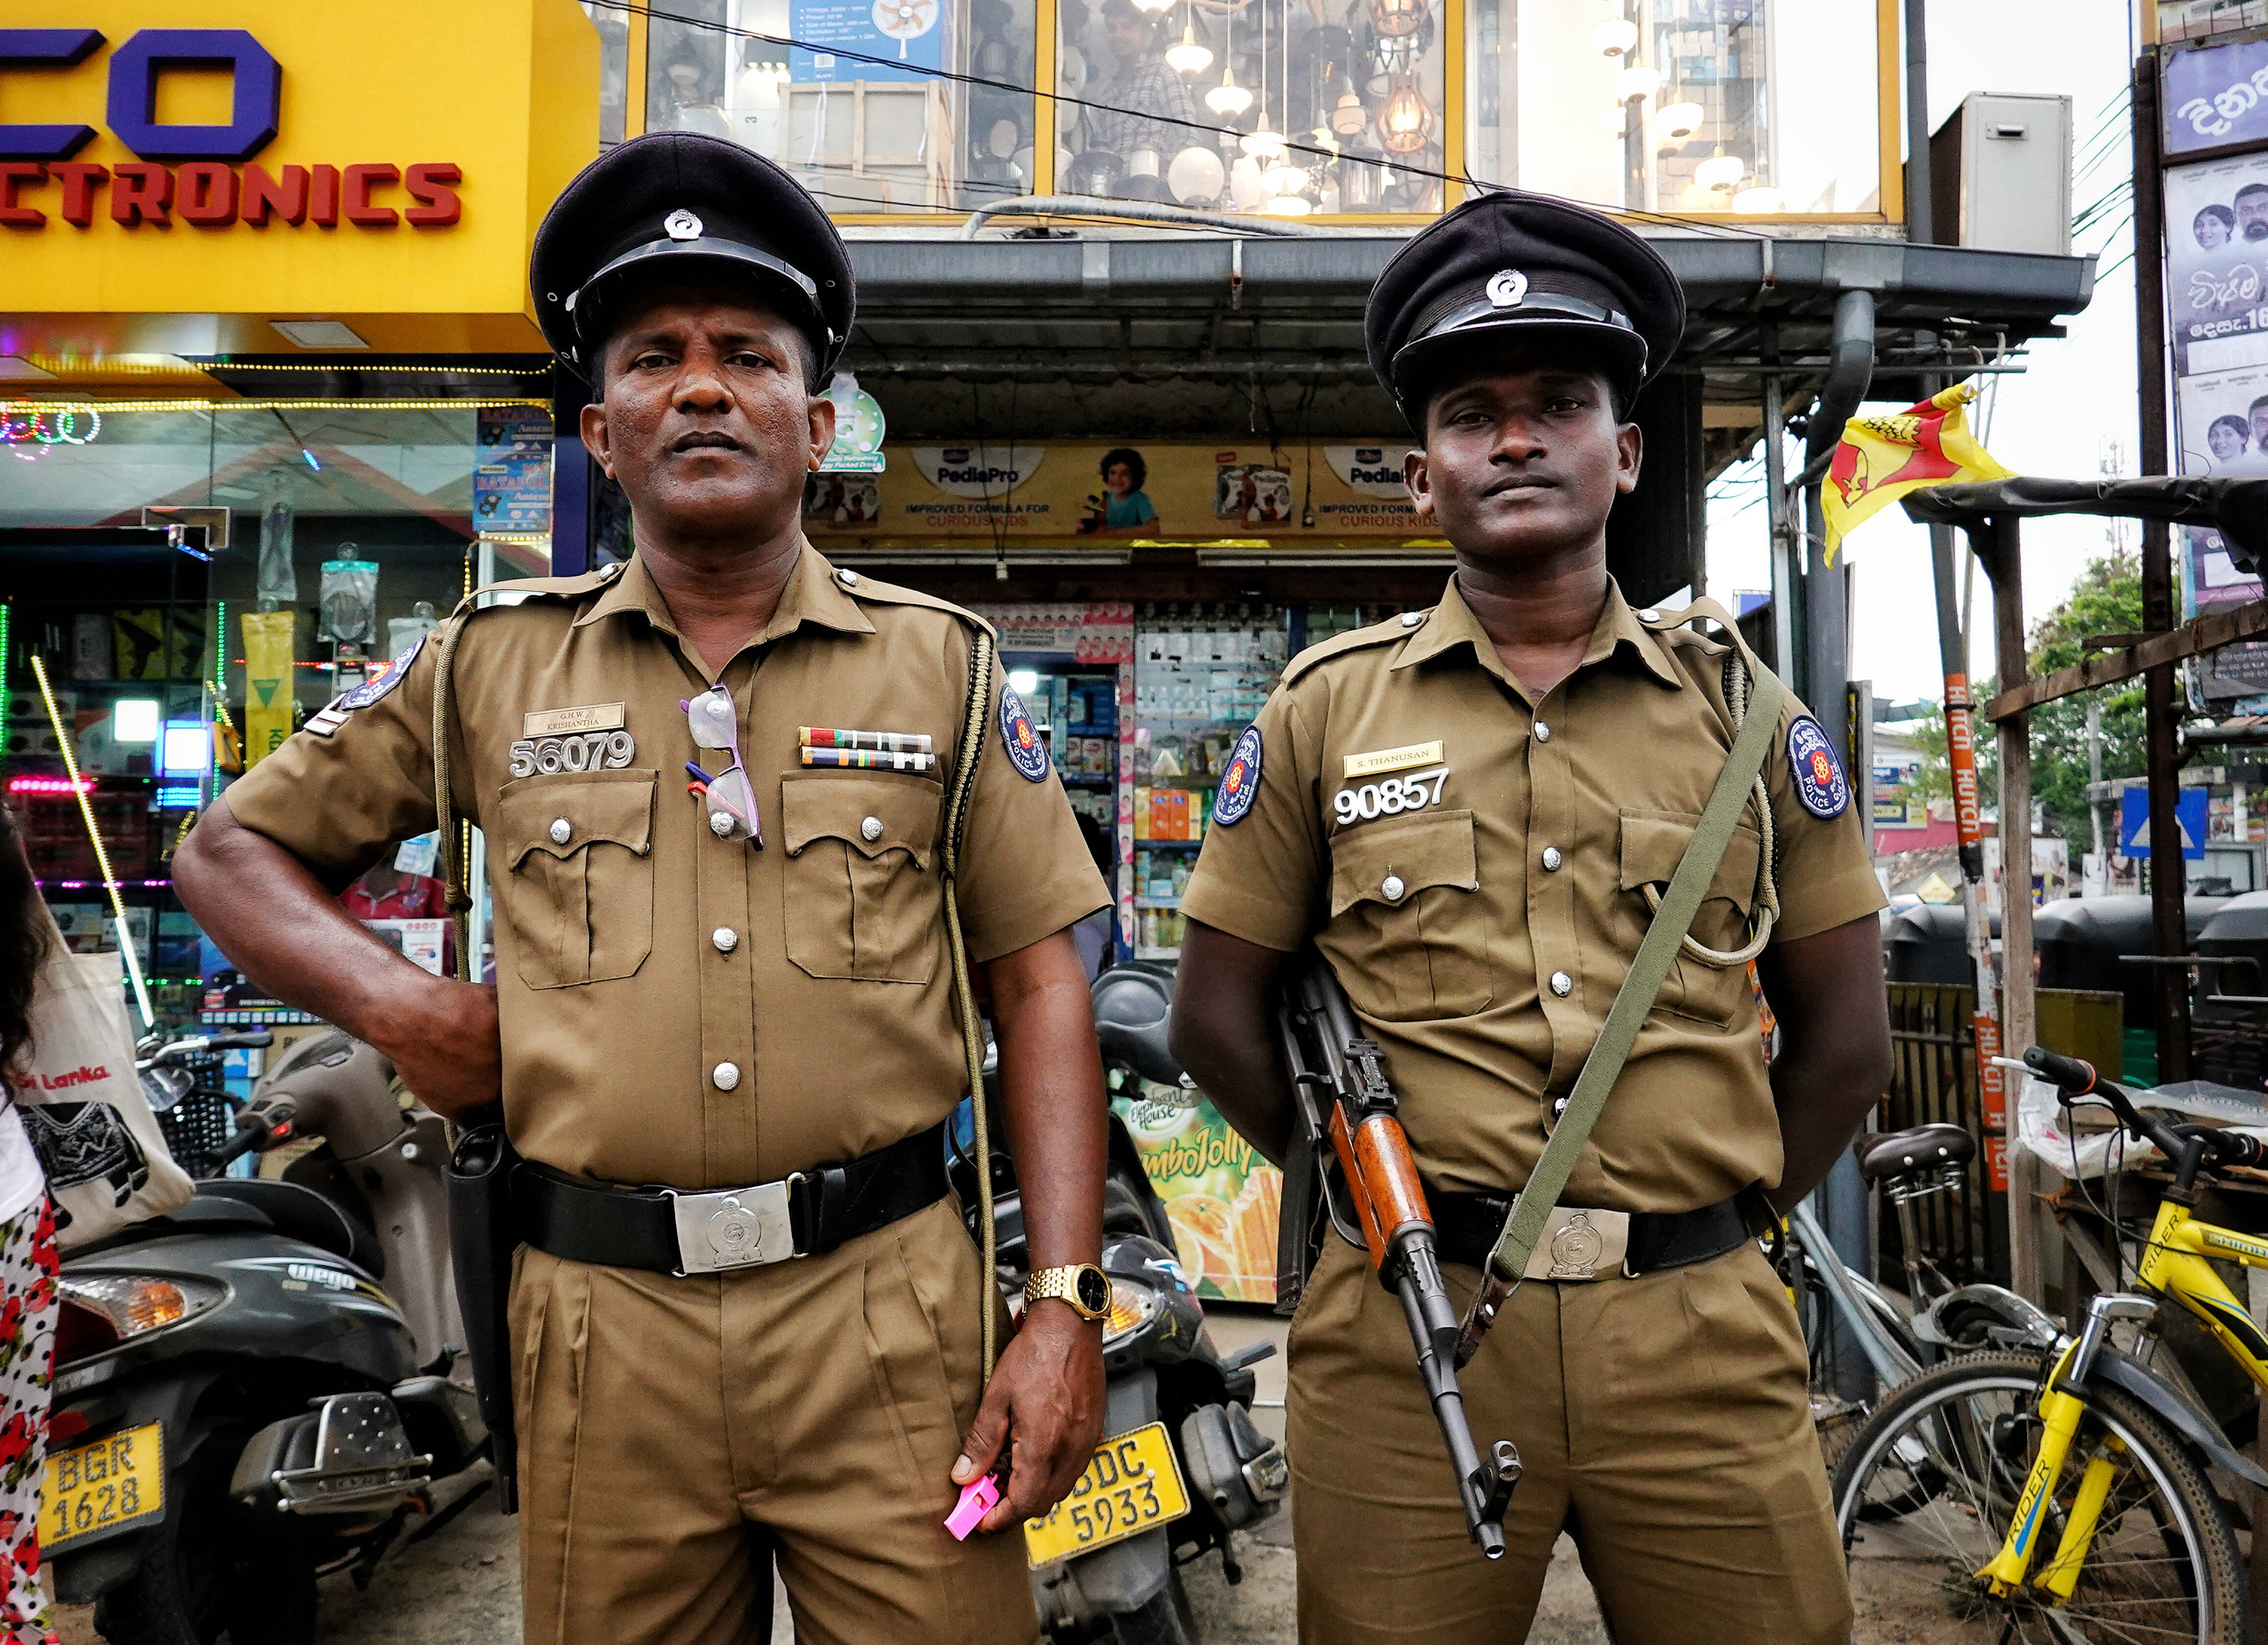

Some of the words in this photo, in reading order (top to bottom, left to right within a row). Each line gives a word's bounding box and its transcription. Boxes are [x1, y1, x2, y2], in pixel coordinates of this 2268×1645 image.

[937, 468, 1019, 484] PediaPro
[1350, 468, 1404, 484] Pedia
[906, 504, 965, 514] IMPROVED
[968, 504, 1022, 514] FORMULA
[1026, 504, 1049, 514] FOR
[927, 515, 990, 526] CURIOUS
[1319, 504, 1379, 514] IMPROVED
[1381, 504, 1418, 514] FORM
[1340, 516, 1405, 527] CURIOUS
[1409, 516, 1439, 527] KIDS
[547, 718, 599, 731] KRISHANTHA
[509, 730, 635, 778] 56079
[1011, 739, 1034, 768] POLICE
[1368, 750, 1430, 766] THANUSAN
[1333, 767, 1449, 826] 90857
[1804, 776, 1829, 808] POLICE
[41, 1066, 112, 1090] Lanka
[1139, 1103, 1177, 1130] House
[1141, 1126, 1254, 1181] mboJolly
[2143, 1214, 2179, 1276] RIDER
[58, 1435, 135, 1494] BGR
[53, 1477, 141, 1539] 1628
[1070, 1479, 1160, 1542] 5933
[2008, 1459, 2050, 1544] RIDER
